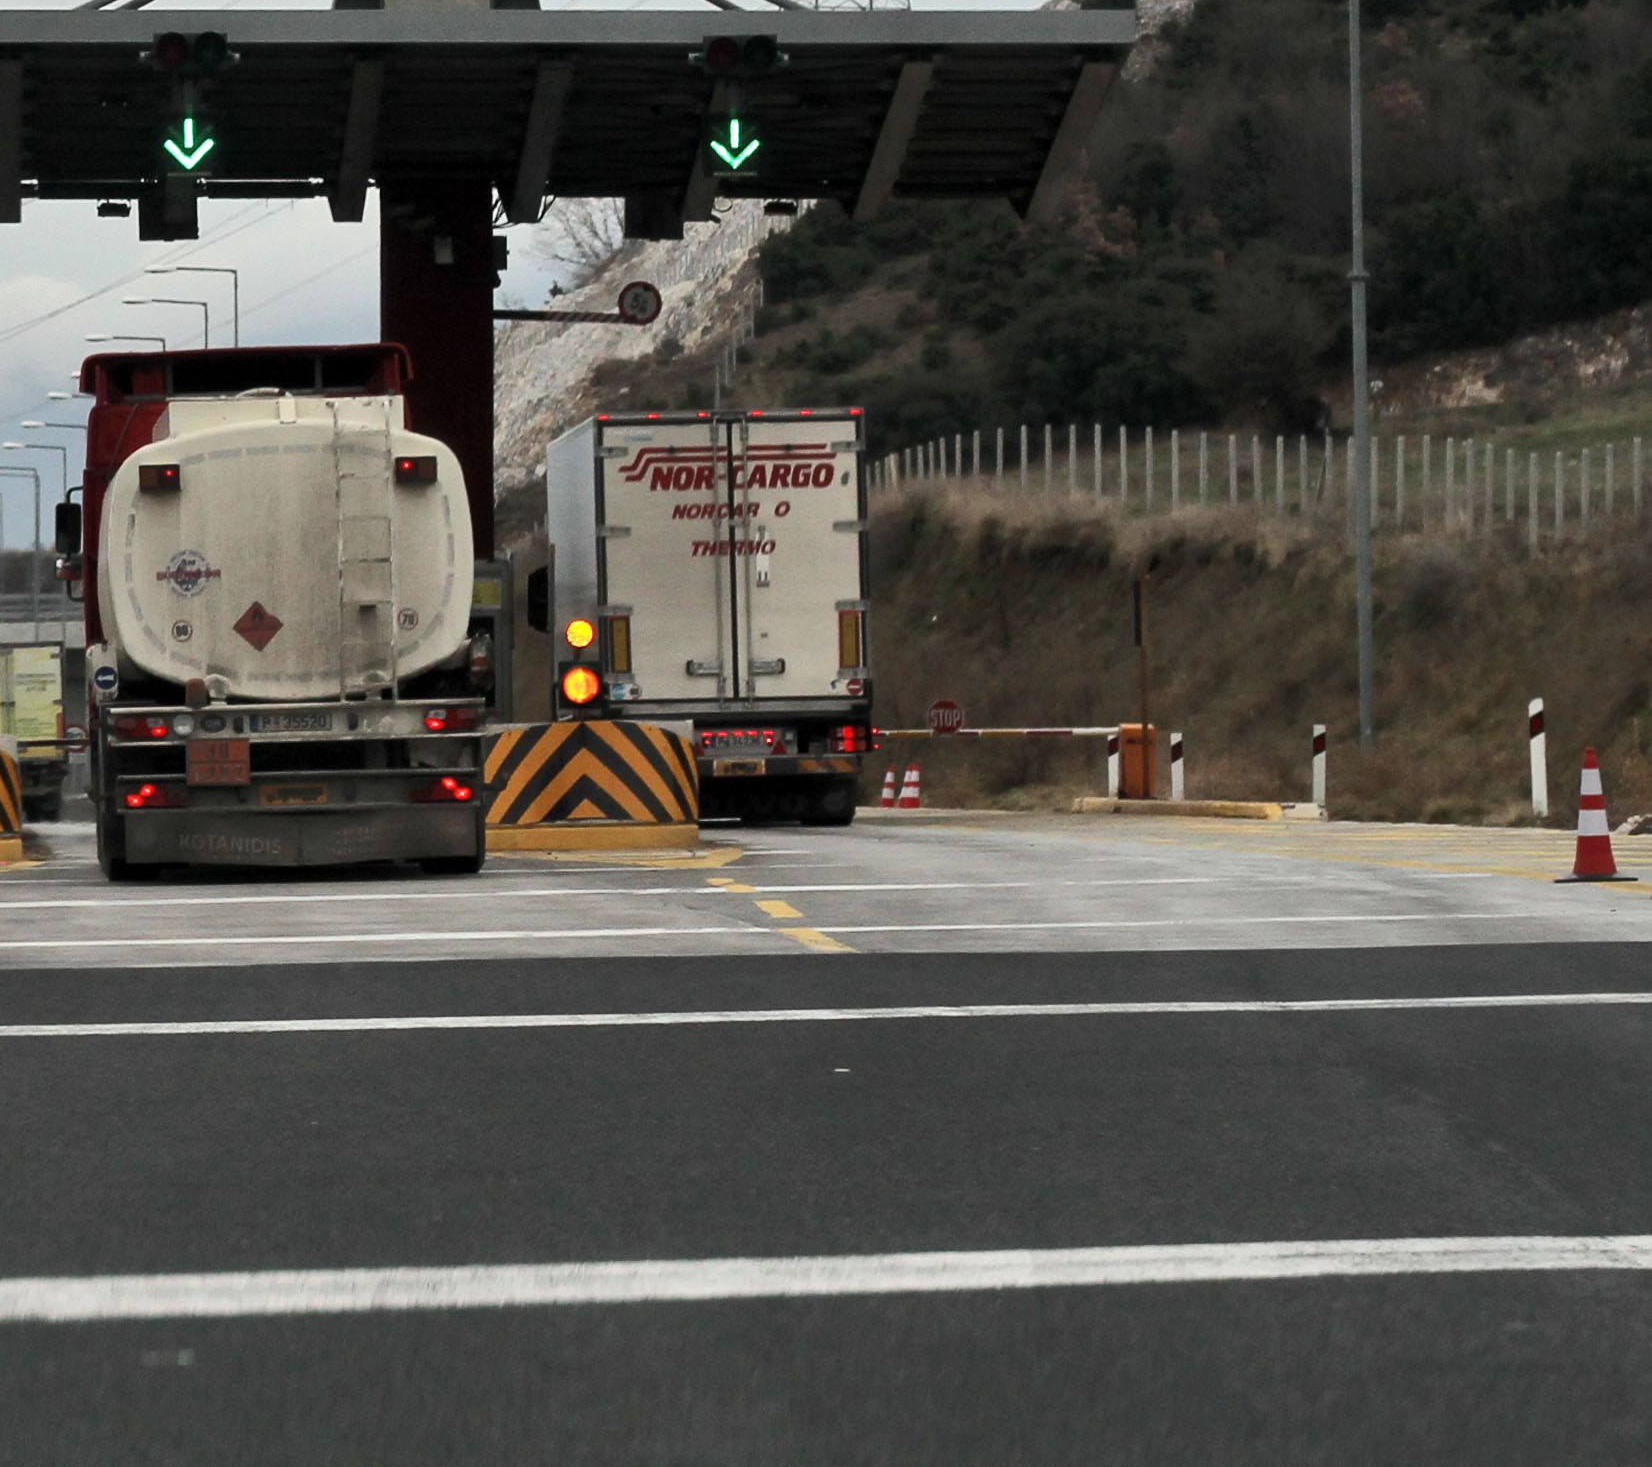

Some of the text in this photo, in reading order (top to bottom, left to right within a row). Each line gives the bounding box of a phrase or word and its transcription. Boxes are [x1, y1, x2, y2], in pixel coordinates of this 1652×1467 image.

[691, 539, 776, 557] THERMO
[930, 709, 961, 727] STOP
[179, 834, 282, 854] KOTANIDIS
